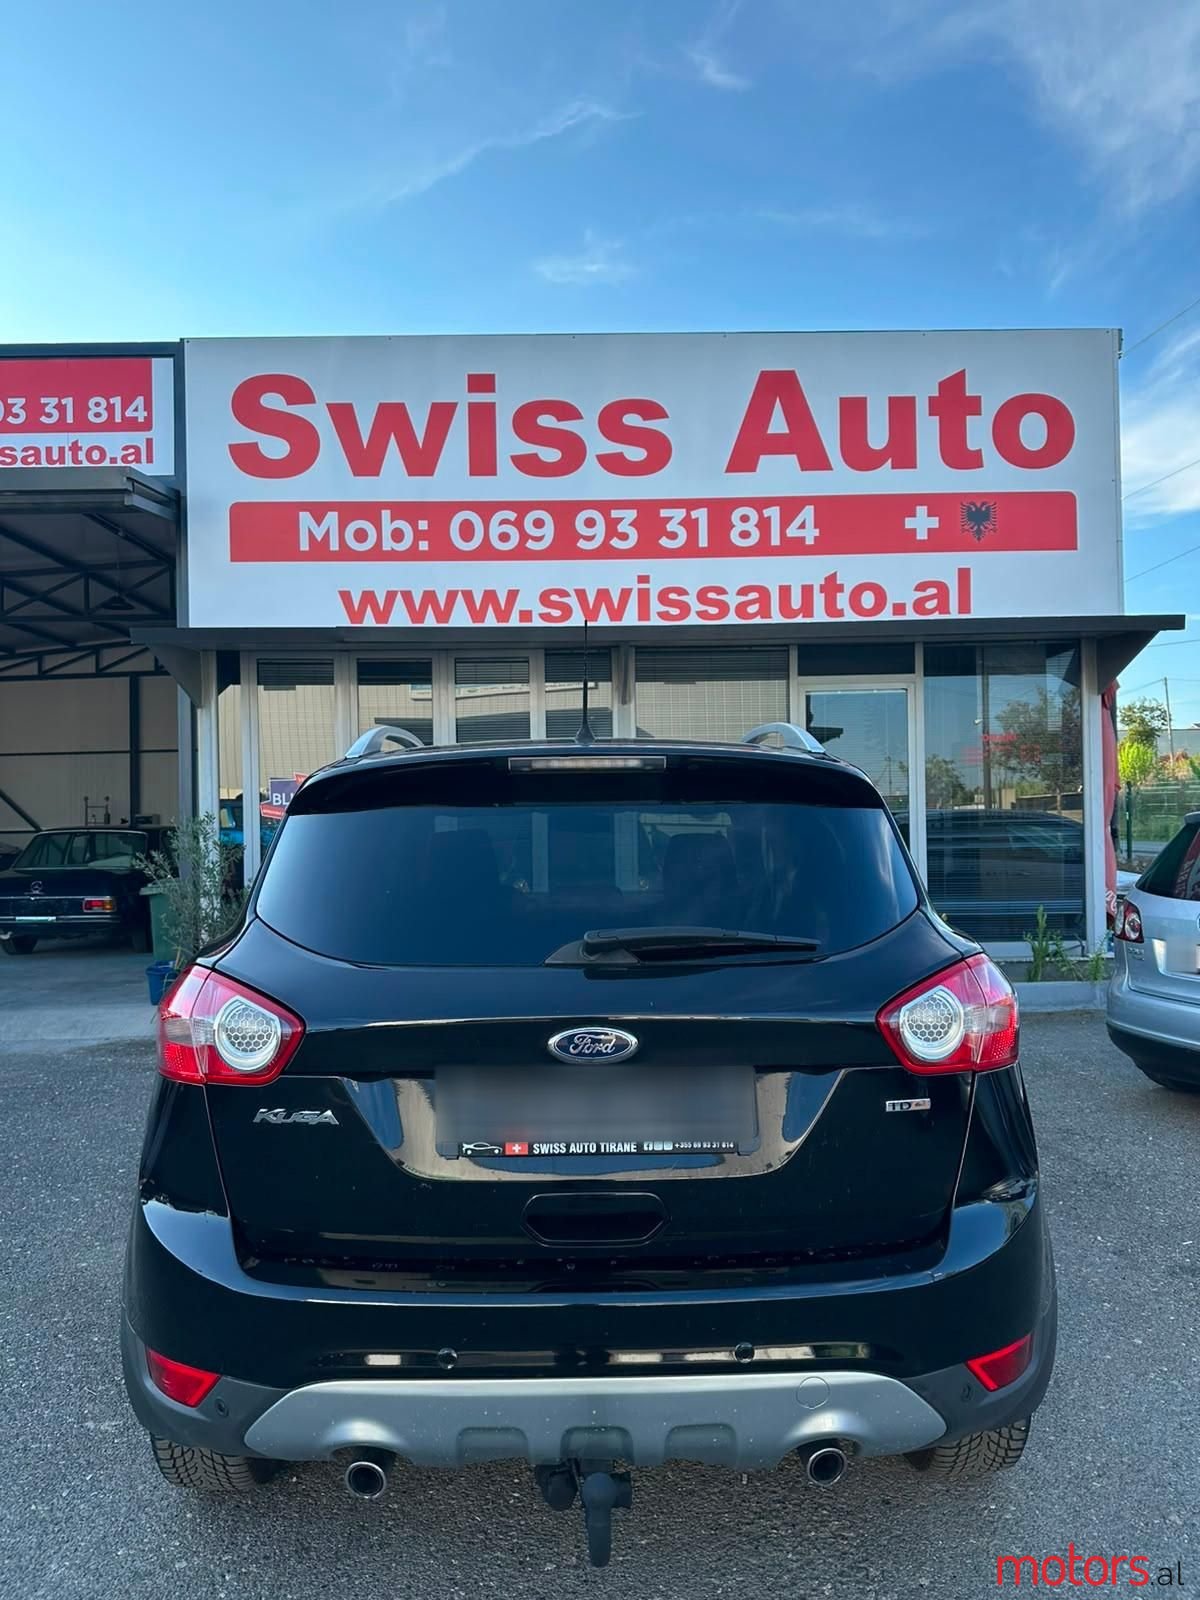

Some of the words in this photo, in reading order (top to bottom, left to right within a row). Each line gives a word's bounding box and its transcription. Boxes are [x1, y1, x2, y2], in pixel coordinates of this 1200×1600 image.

[0, 398, 27, 424] 3
[40, 397, 74, 424] 31
[87, 396, 148, 424] 814
[228, 373, 673, 479] Swiss
[725, 368, 1076, 474] Auto
[298, 510, 430, 552] Mob:
[450, 509, 555, 551] 069
[574, 508, 639, 551] 93
[658, 507, 710, 549] 31
[729, 504, 820, 548] 814
[338, 567, 972, 625] www.swissauto.al
[272, 792, 294, 806] BL
[569, 1033, 616, 1054] Ford
[252, 1108, 340, 1125] KUGA
[532, 1142, 567, 1155] SWISS
[569, 1142, 597, 1153] AUTO
[599, 1142, 638, 1153] TIRANE
